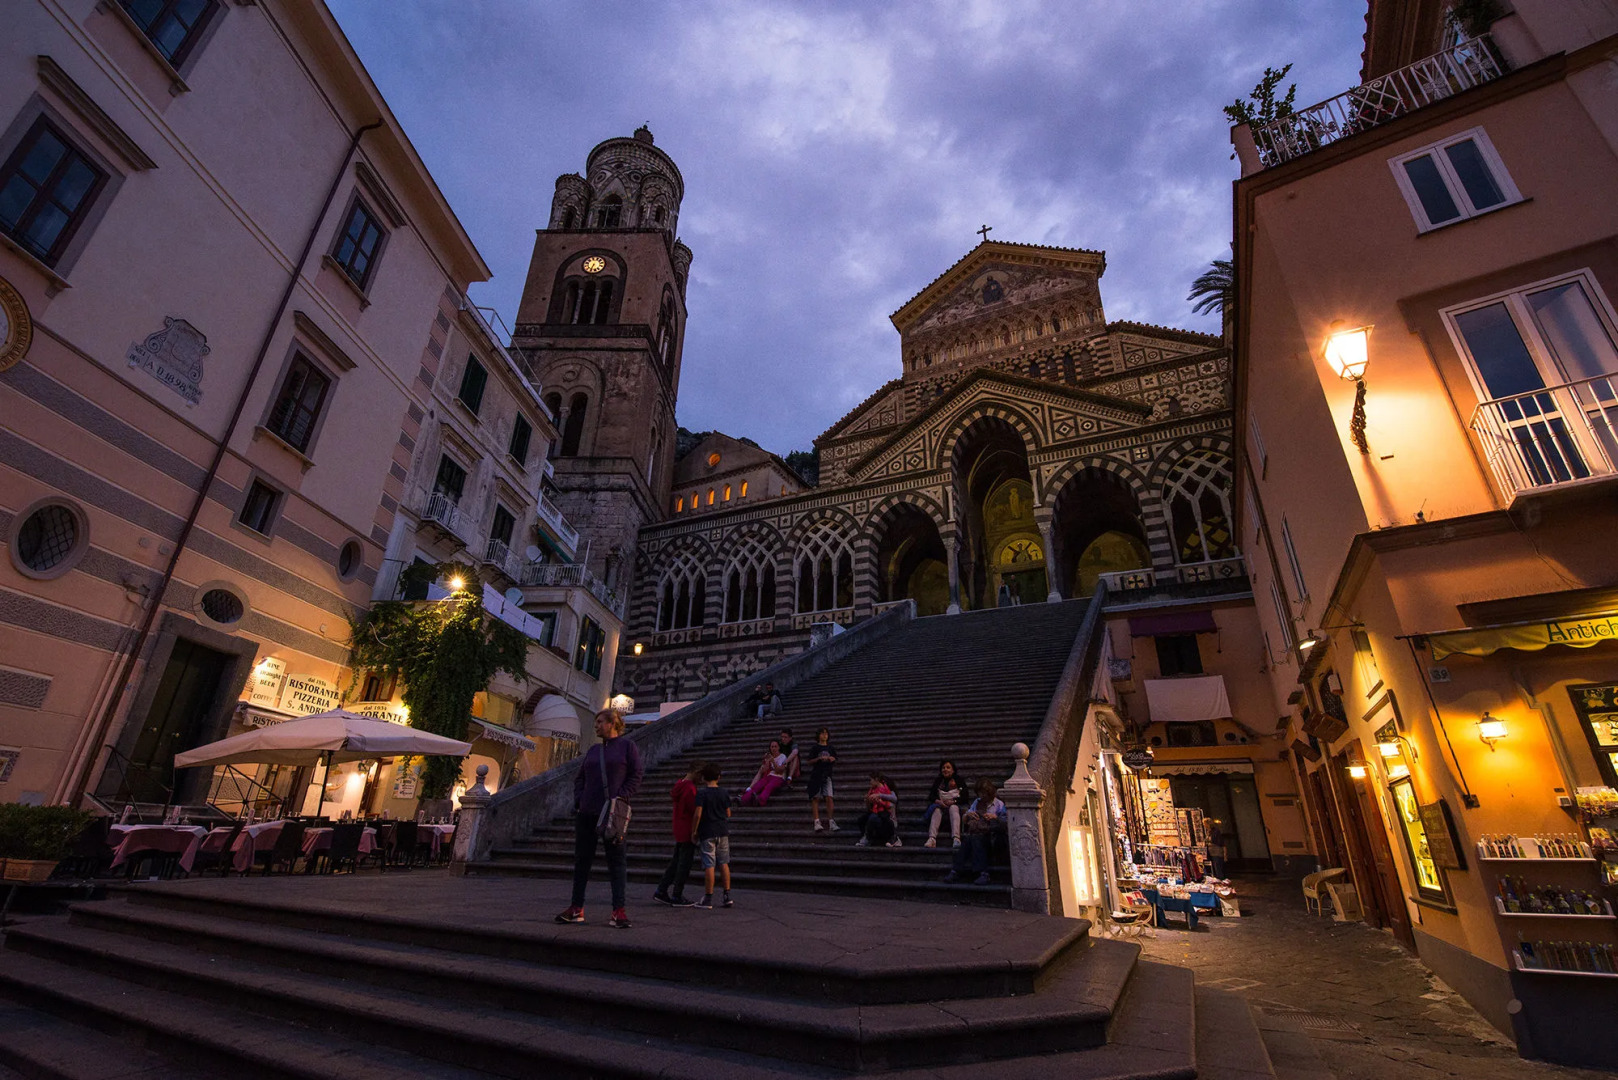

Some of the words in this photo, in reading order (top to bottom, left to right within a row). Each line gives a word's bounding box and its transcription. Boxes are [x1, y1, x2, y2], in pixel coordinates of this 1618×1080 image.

[164, 372, 187, 392] 1898
[259, 679, 276, 688] BEER
[289, 678, 340, 700] RISTORANTE
[286, 700, 295, 709] S.
[298, 703, 330, 714] ANDRE
[293, 691, 330, 708] PIZZERIA
